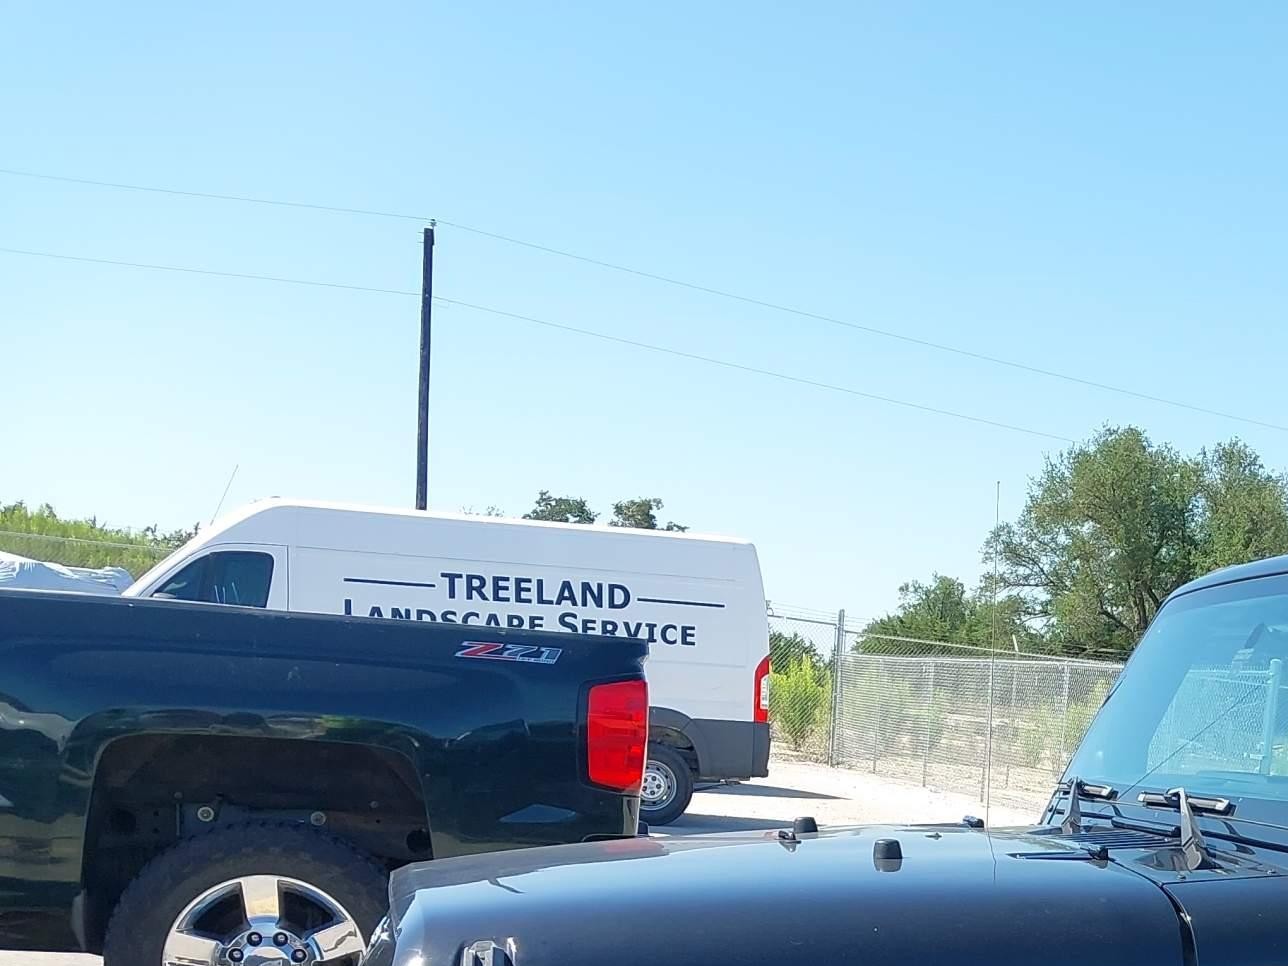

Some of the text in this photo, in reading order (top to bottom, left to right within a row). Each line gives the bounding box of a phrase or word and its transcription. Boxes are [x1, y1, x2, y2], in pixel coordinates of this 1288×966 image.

[441, 572, 631, 609] TREELAND
[558, 612, 696, 646] SERVICE
[455, 641, 562, 664] Z71
